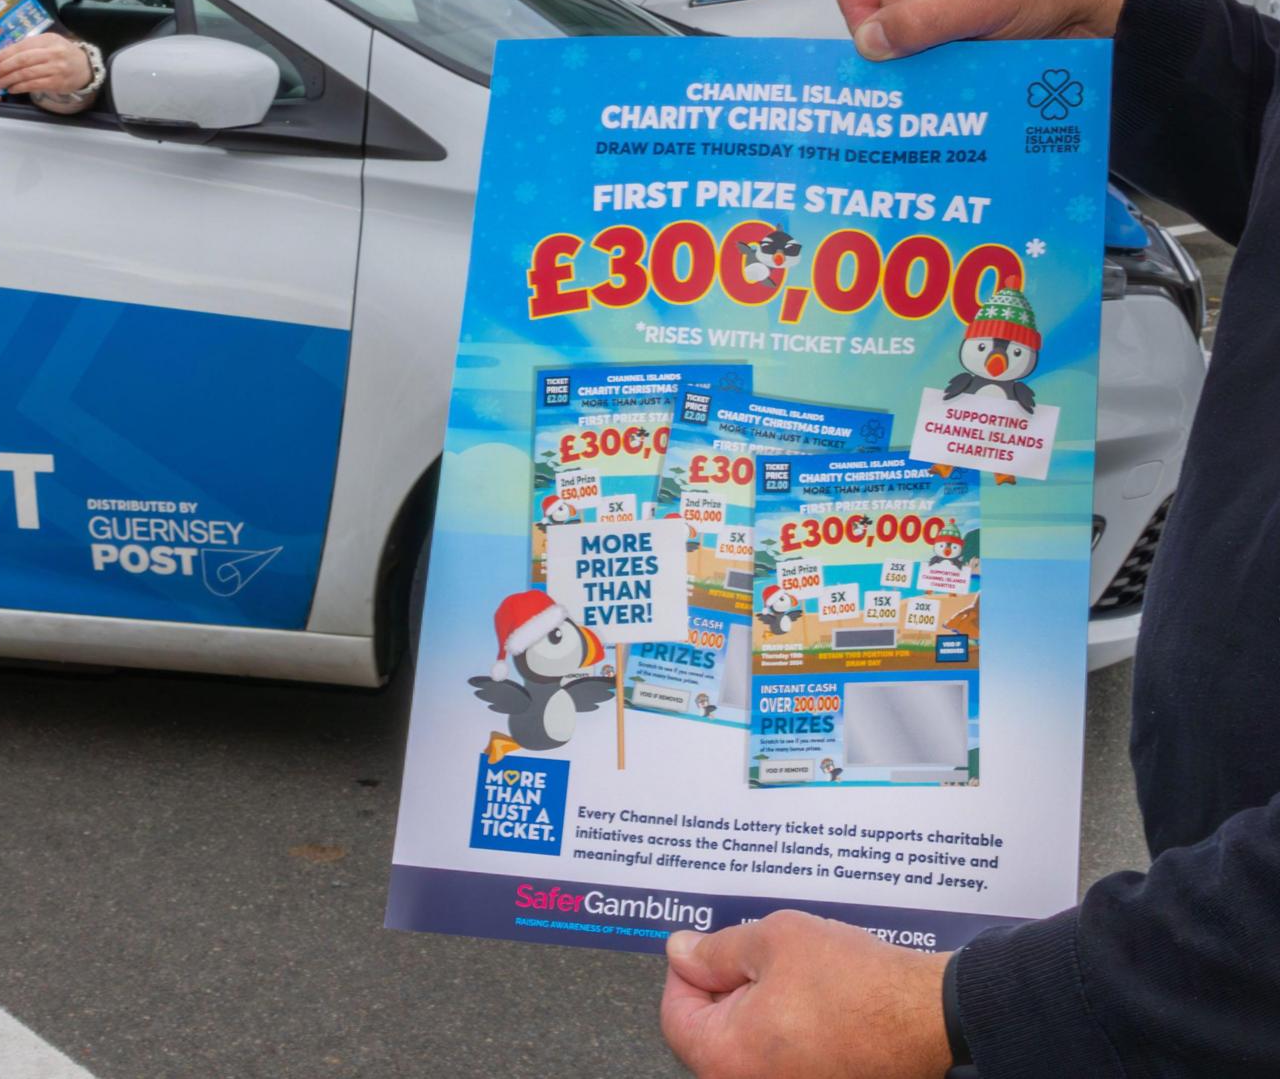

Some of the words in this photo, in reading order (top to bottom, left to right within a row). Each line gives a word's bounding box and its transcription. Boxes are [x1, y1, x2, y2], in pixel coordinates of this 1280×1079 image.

[686, 83, 796, 102] CHANNEL
[802, 85, 903, 108] ISLANDS
[601, 105, 723, 130] CHARITY
[728, 107, 893, 138] CHRISTMAS
[899, 112, 988, 137] DRAW
[1025, 126, 1081, 135] CHANNEL
[1025, 135, 1081, 144] ISLANDS
[596, 141, 648, 155] DRAW
[653, 142, 696, 155] DATE
[701, 142, 793, 158] THURSDAY
[798, 146, 839, 161] 19TH
[844, 149, 940, 164] DECEMBER
[946, 149, 987, 163] 2024
[1025, 144, 1080, 153] LOTTERY
[593, 182, 688, 212] FIRST
[696, 181, 796, 211] PRIZE
[805, 186, 935, 222] STARTS
[942, 195, 991, 224] AT
[708, 327, 765, 349] WITH
[771, 331, 845, 353] TICKET
[850, 335, 915, 354] SALES
[607, 374, 645, 383] CHANNEL
[578, 386, 620, 396] CHARITY
[622, 384, 678, 395] CHRISTMAS
[686, 393, 711, 403] TICKET
[685, 401, 708, 412] PRICE
[749, 403, 789, 418] CHANNEL
[578, 416, 611, 427] FIRST
[613, 413, 648, 425] PRIZE
[684, 411, 707, 422] £2.00
[717, 409, 761, 426] CHARITY
[762, 414, 820, 434] CHRISTMAS
[821, 425, 853, 438] DRAW
[946, 408, 1029, 430] SUPPORTING
[719, 423, 746, 436] MORE
[752, 428, 776, 439] THAN
[778, 432, 801, 443] JUST
[813, 437, 846, 449] TICKET
[925, 422, 985, 440] CHANNEL
[989, 432, 1044, 449] ISLANDS
[713, 440, 746, 452] FIRST
[947, 441, 1015, 462] CHARITIES
[765, 463, 789, 471] TICKET
[829, 461, 869, 469] CHANNEL
[870, 459, 905, 468] ISLANDS
[561, 478, 575, 487] 2nd
[577, 475, 596, 485] Prize
[765, 471, 789, 480] PRICE
[799, 471, 843, 483] CHARITY
[844, 470, 902, 482] CHRISTMAS
[561, 485, 598, 500] £50,000
[766, 481, 788, 490] £2.00
[803, 485, 831, 495] MORE
[834, 484, 861, 494] THAN
[863, 483, 884, 493] JUST
[897, 482, 931, 491] TICKET
[87, 499, 176, 513] DISTRIBUTED
[179, 502, 198, 513] BY
[609, 502, 624, 513] 5X
[686, 499, 700, 507] 2nd
[702, 499, 721, 508] Prize
[800, 503, 833, 515] FIRST
[836, 501, 869, 513] PRIZE
[871, 500, 916, 511] STARTS
[918, 499, 936, 510] AT
[684, 510, 721, 523] £50,000
[88, 516, 244, 545] GUERNSEY
[730, 532, 745, 543] 5X
[581, 533, 652, 555] MORE
[91, 543, 198, 575] POST
[576, 556, 658, 579] PRIZES
[782, 568, 796, 577] 2nd
[798, 565, 817, 575] Prize
[891, 563, 905, 571] 25X
[782, 575, 820, 590] £50,000
[885, 574, 907, 583] £500
[584, 580, 651, 602] THAN
[831, 591, 846, 603] 5X
[873, 597, 891, 607] 15X
[915, 603, 931, 611] 20X
[584, 603, 652, 625] EVER!
[822, 603, 856, 616] £10,000
[867, 608, 896, 619] £2,000
[693, 617, 723, 630] CASH
[908, 614, 935, 625] £1,000
[641, 642, 716, 669] PRIZES
[761, 684, 805, 694] INSTANT
[807, 683, 837, 693] CASH
[760, 698, 791, 713] OVER
[793, 696, 840, 714] 200,000
[760, 715, 835, 734] PRIZES
[485, 786, 542, 805] THAN
[482, 802, 530, 821] JUST
[535, 808, 550, 824] A
[481, 820, 556, 842] TICKET.
[578, 806, 616, 824] Every
[620, 809, 677, 827] Channel
[682, 815, 730, 831] Islands
[733, 819, 782, 835] Lottery
[785, 821, 824, 836] ticket
[828, 824, 857, 838] sold
[860, 827, 923, 842] supports
[927, 829, 1003, 848] charitable
[575, 826, 644, 843] initiatives
[647, 835, 692, 848] across
[695, 836, 719, 851] the
[722, 838, 778, 853] Channel
[781, 841, 833, 858] Islands,
[837, 846, 891, 864] making
[896, 851, 904, 862] a
[908, 851, 966, 867] positive
[970, 855, 999, 869] and
[573, 848, 652, 866] meaningful
[656, 853, 726, 872] difference
[730, 859, 748, 872] for
[751, 860, 813, 876] Islanders
[817, 864, 829, 877] in
[833, 865, 900, 886] Guernsey
[904, 871, 933, 885] and
[937, 874, 988, 893] Jersey.
[515, 883, 713, 931] SaferGambling
[515, 917, 548, 928] RAISING
[549, 920, 601, 933] AWARENESS
[602, 924, 613, 933] OF
[616, 925, 632, 936] THE
